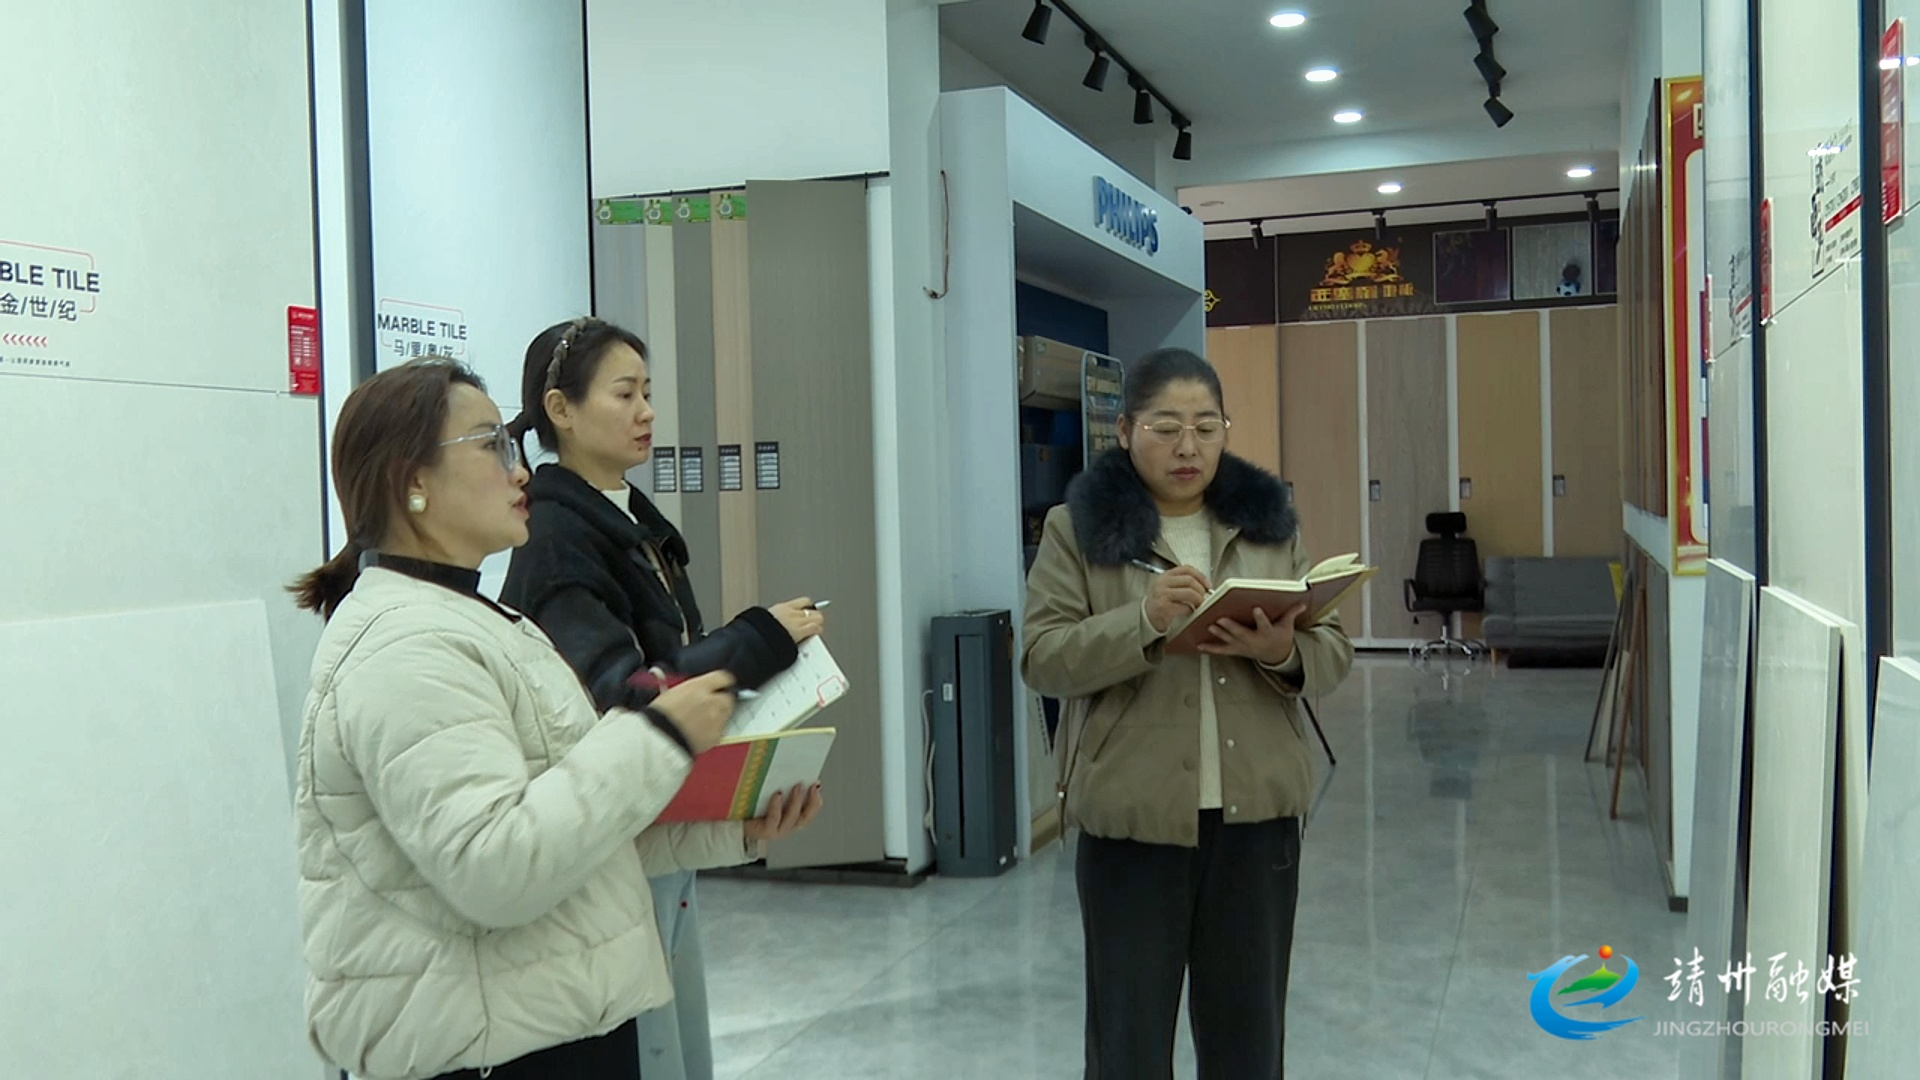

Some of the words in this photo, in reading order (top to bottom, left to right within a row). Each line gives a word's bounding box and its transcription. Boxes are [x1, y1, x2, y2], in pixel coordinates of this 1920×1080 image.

[1093, 175, 1159, 254] PHILIPS
[52, 267, 100, 293] TILE
[377, 313, 436, 336] MARBLE
[439, 322, 467, 340] TILE
